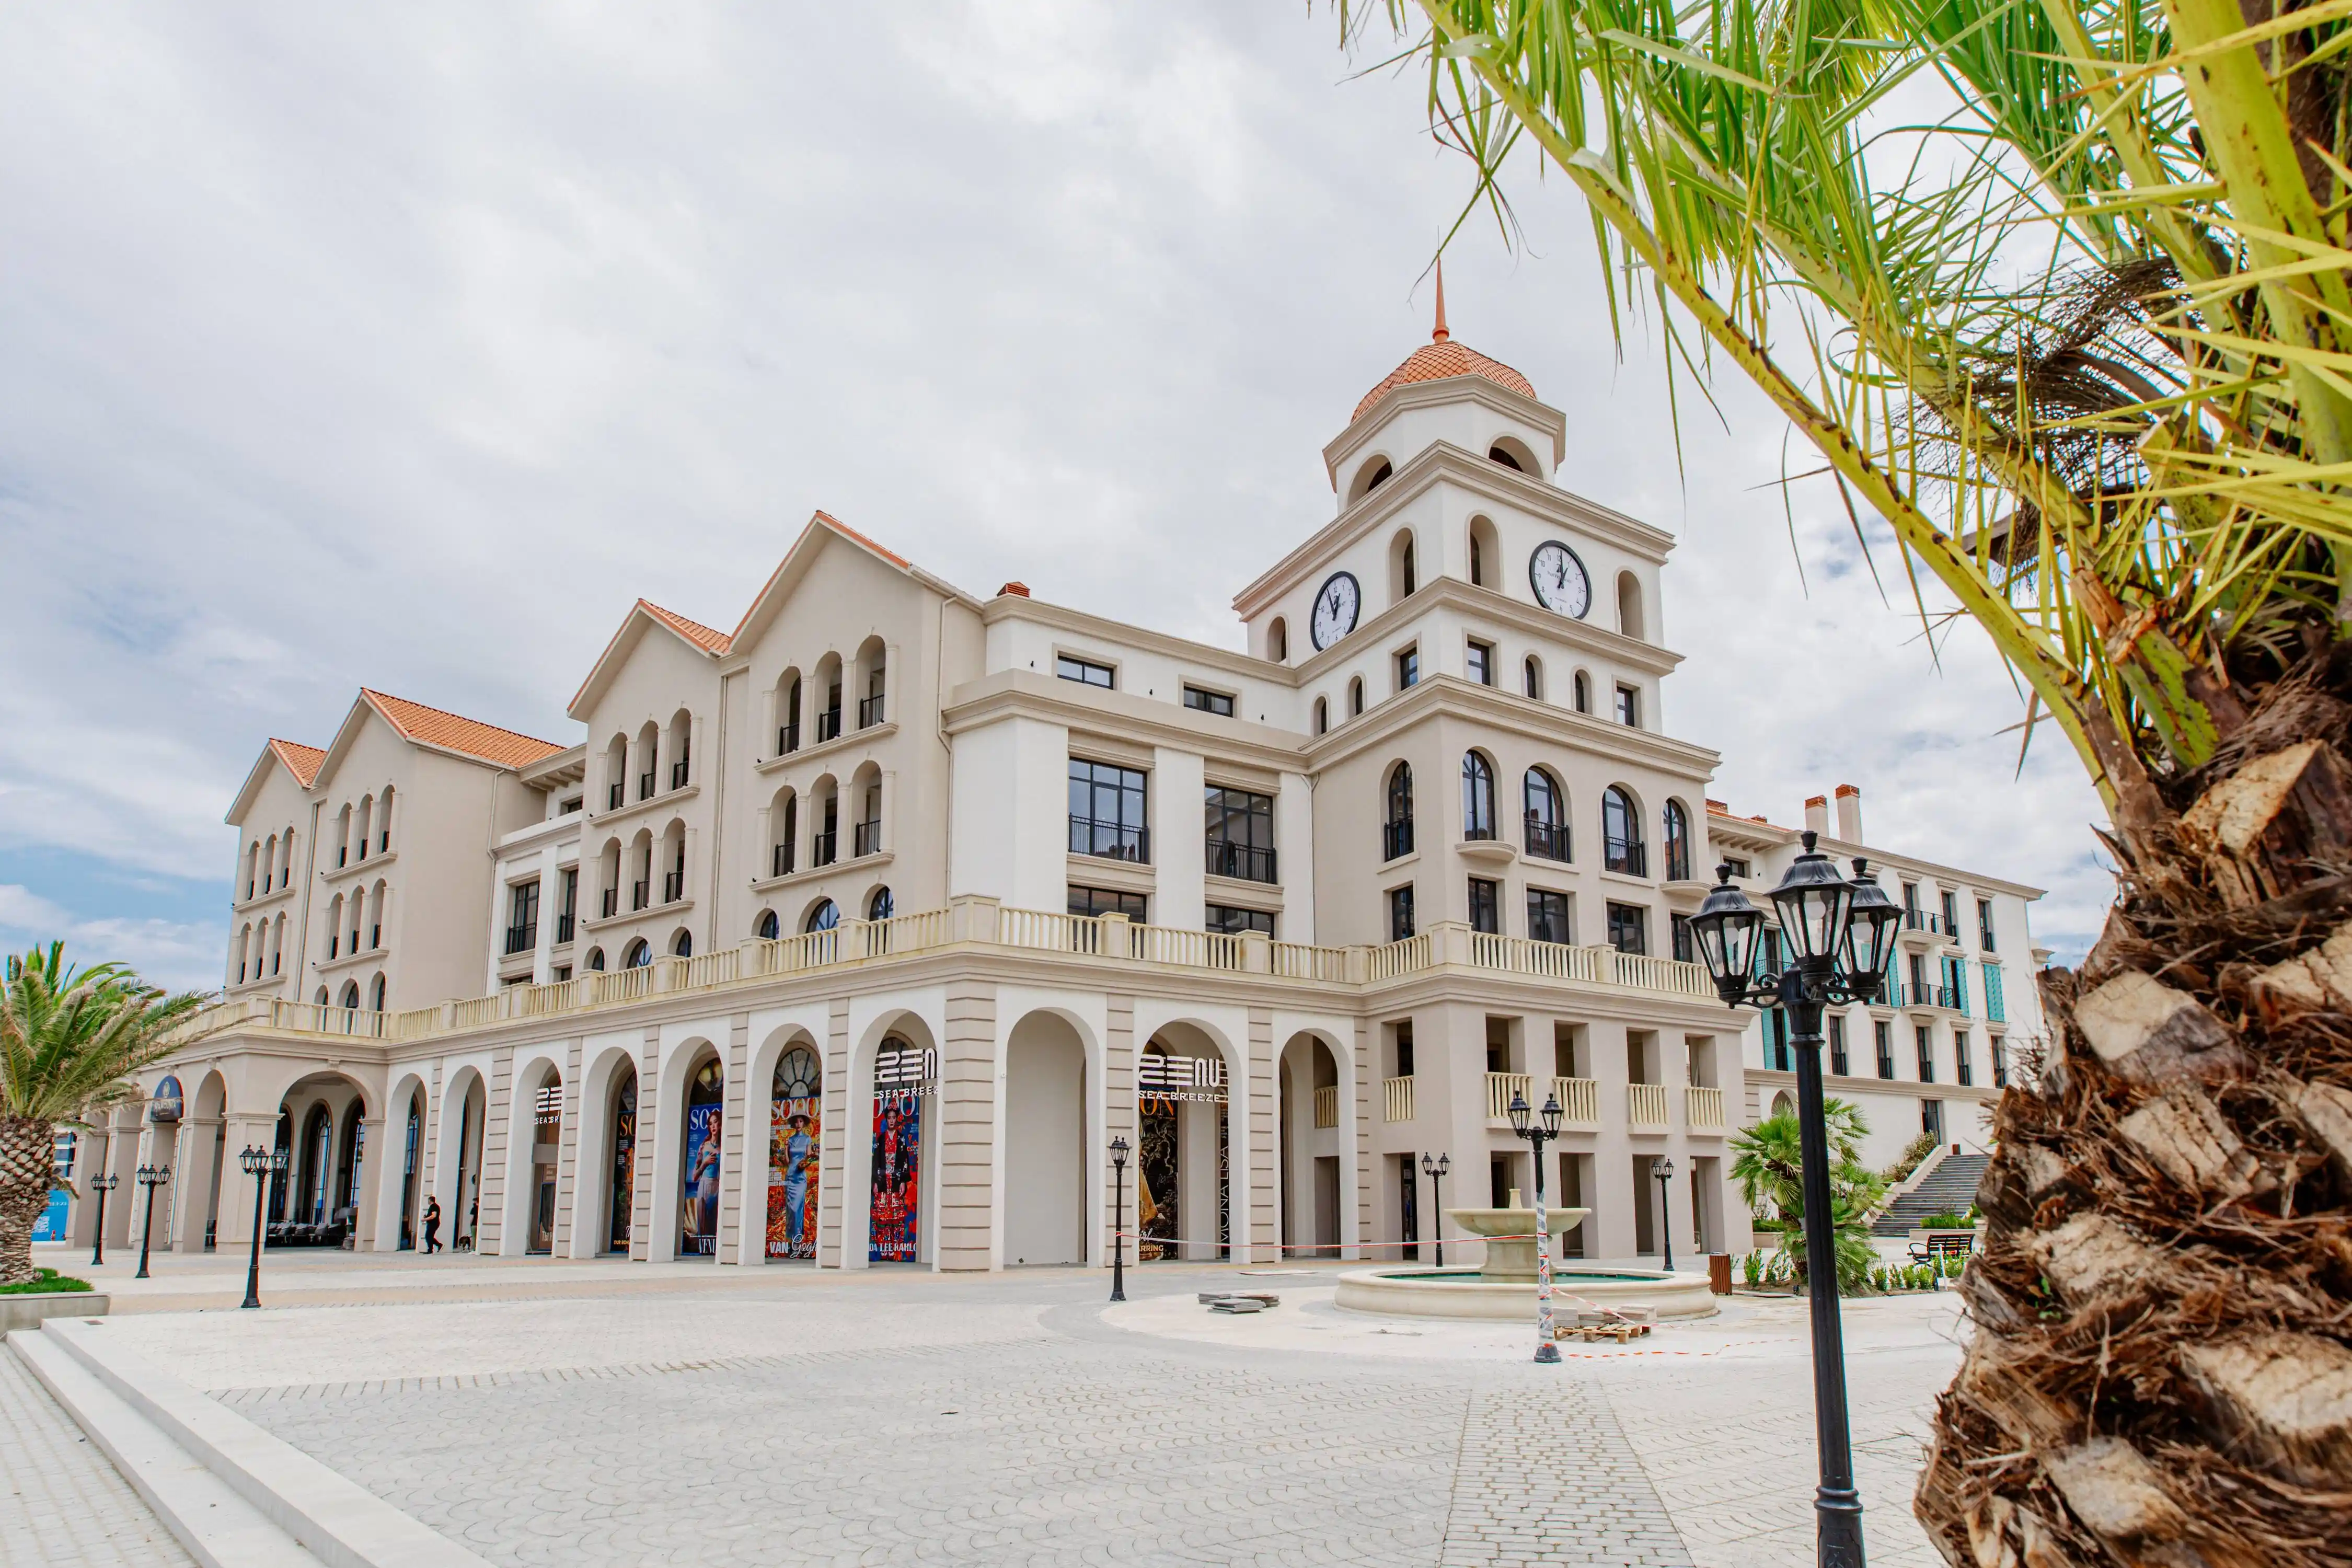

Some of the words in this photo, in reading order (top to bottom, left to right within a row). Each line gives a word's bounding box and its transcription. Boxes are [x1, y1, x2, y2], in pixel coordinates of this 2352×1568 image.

[879, 1089, 899, 1098] SEA
[1138, 1090, 1162, 1100] SEA
[1170, 1091, 1220, 1103] BREEZE
[535, 1116, 548, 1125] SEA
[1139, 1227, 1153, 1241] irl
[769, 1241, 789, 1253] VAN
[880, 1243, 893, 1252] LEE
